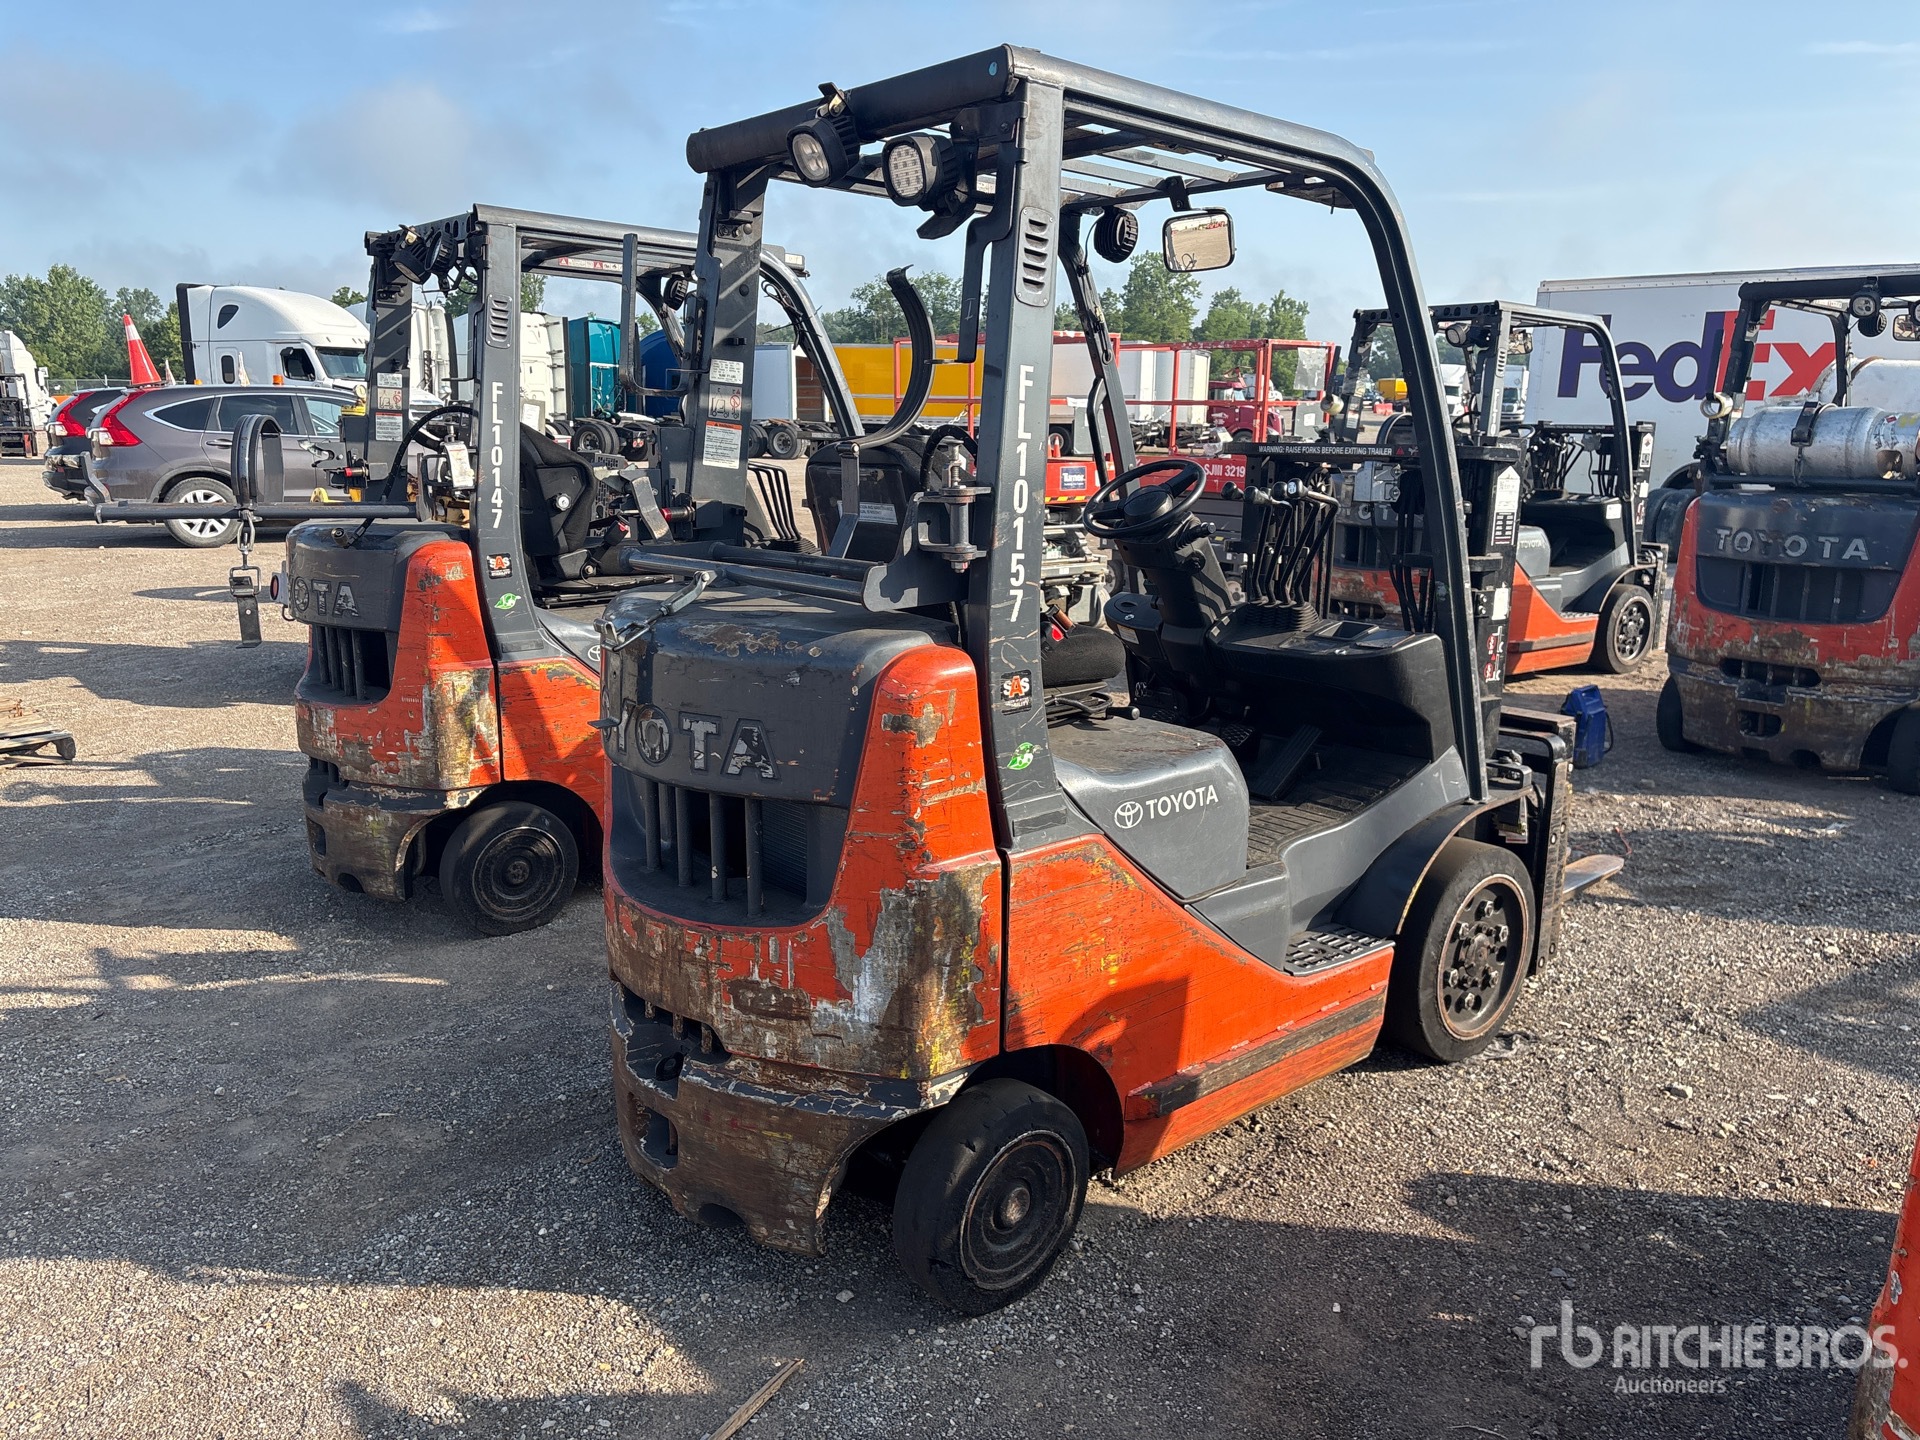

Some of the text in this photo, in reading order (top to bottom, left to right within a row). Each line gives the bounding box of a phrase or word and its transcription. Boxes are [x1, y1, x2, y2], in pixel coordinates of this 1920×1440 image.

[1557, 310, 1838, 402] FedEx
[491, 381, 504, 529] FL10147
[1258, 445, 1393, 456] WARNING: RAISE FORKS BEFORE EXITING TRAILER
[1224, 465, 1246, 478] 3219
[1009, 364, 1035, 622] FL10157
[1715, 527, 1870, 562] TOYOTA
[489, 555, 510, 570] SAS
[1003, 675, 1030, 698] SAS
[1145, 784, 1219, 819] TOYOTA
